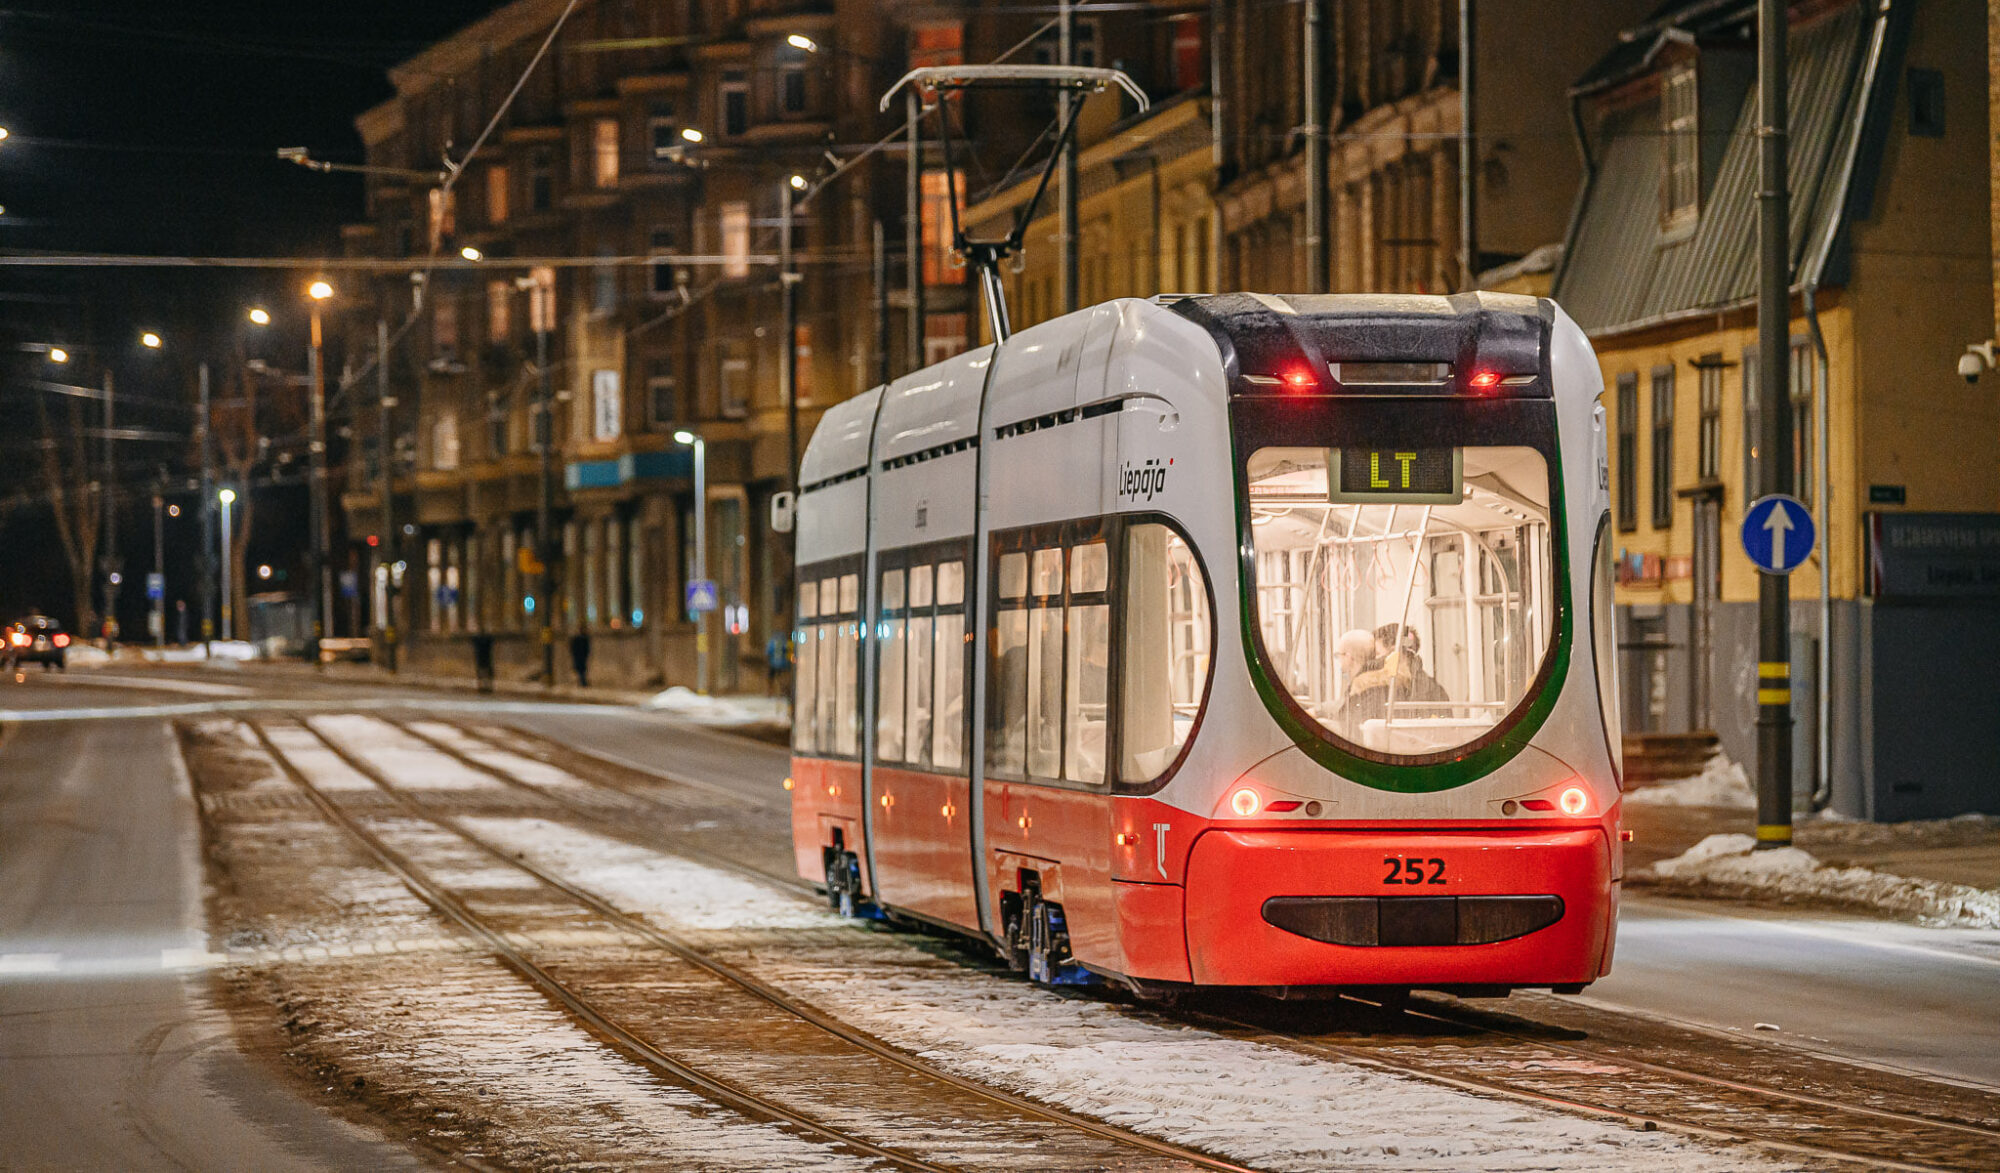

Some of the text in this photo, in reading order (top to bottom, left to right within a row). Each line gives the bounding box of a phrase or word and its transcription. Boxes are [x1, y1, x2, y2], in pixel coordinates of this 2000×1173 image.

[1119, 458, 1166, 502] Liepāja
[1371, 452, 1417, 488] LT
[1383, 858, 1447, 885] 252
